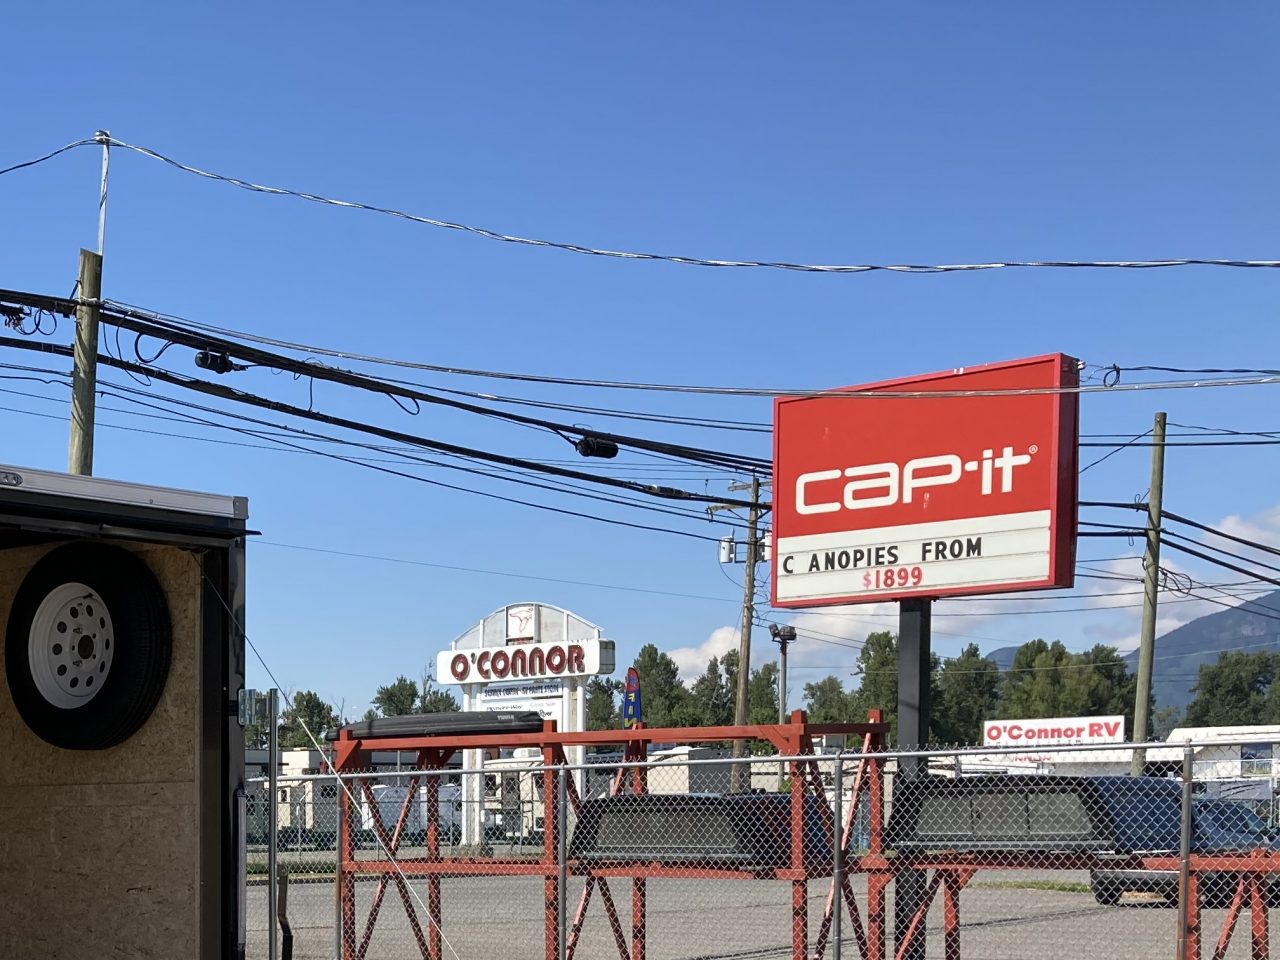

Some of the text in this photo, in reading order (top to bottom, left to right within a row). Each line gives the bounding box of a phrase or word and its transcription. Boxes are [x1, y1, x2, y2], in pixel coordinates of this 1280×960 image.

[795, 446, 1032, 515] cap-it
[921, 537, 982, 562] FROM
[862, 566, 924, 590] $1899
[450, 645, 586, 682] O'CONNOR
[986, 721, 1121, 741] O'Connor RV
